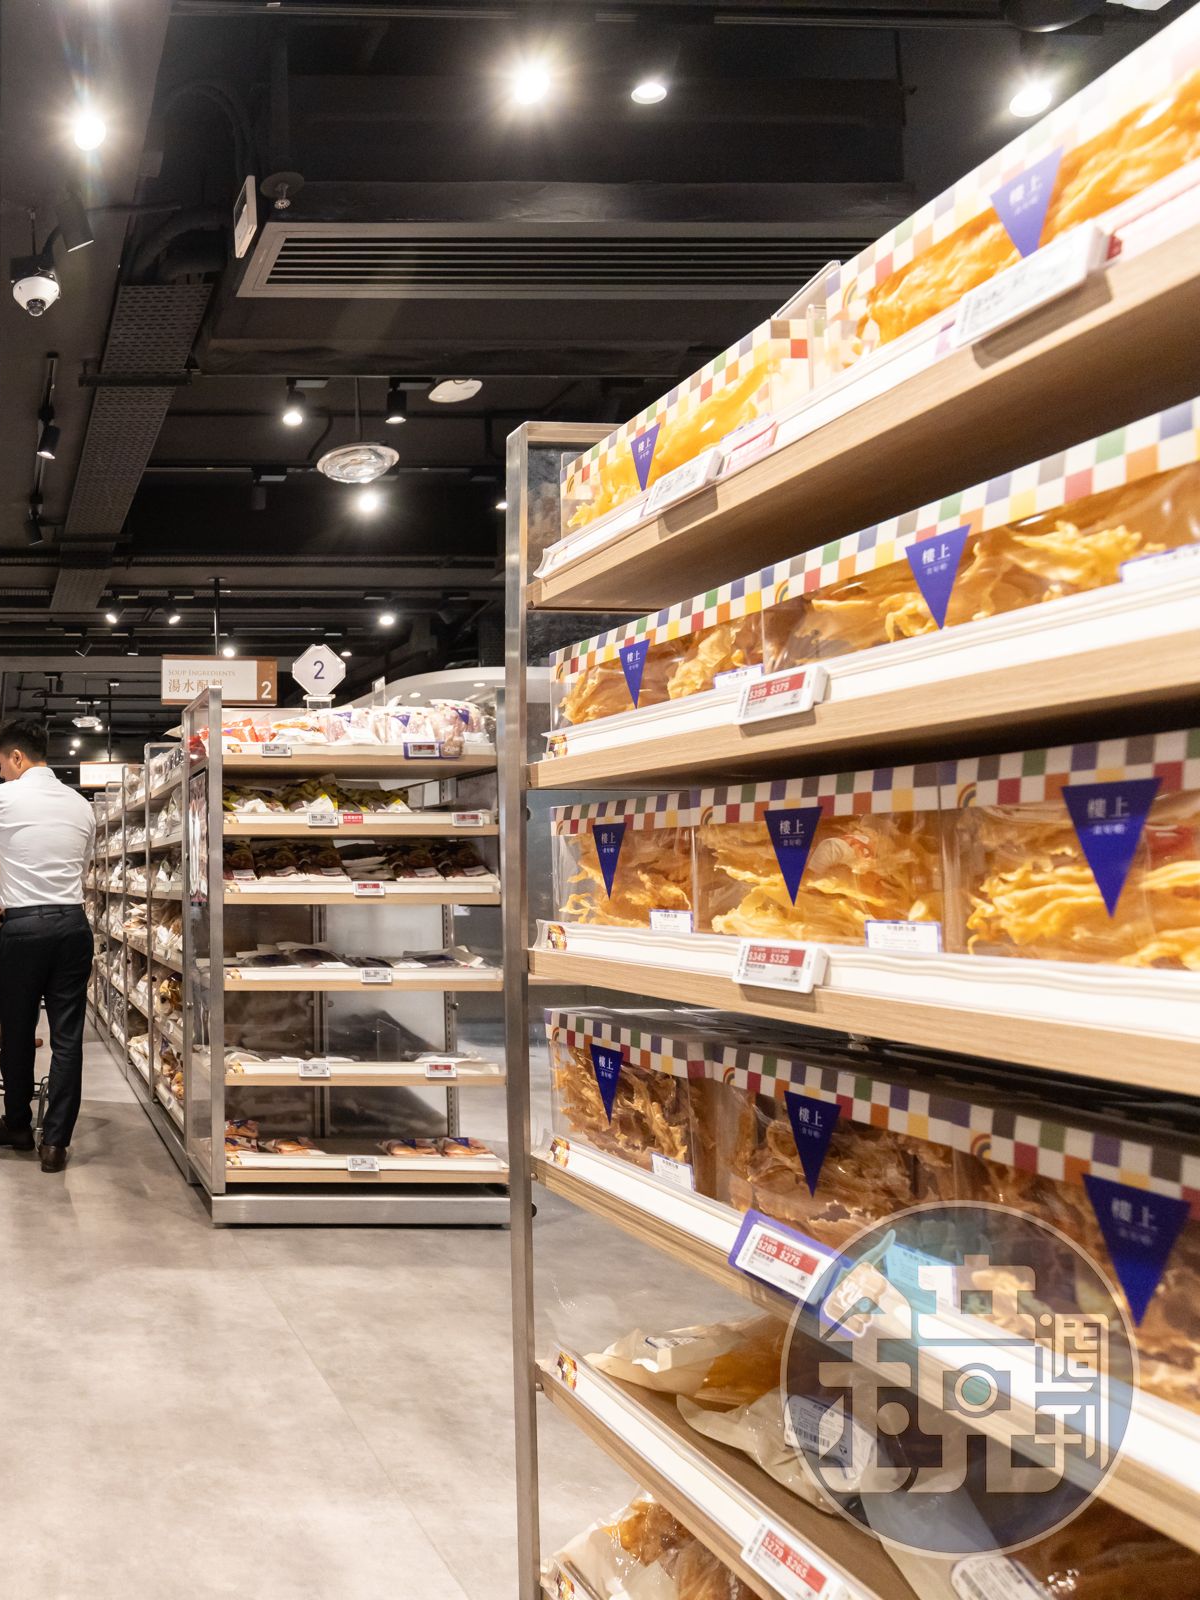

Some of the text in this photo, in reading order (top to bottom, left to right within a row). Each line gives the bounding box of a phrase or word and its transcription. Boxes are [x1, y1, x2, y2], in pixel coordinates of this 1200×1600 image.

[922, 543, 951, 565] 樓上
[313, 660, 325, 680] 2
[261, 680, 272, 699] 2
[770, 682, 790, 695] $379
[1087, 795, 1131, 819] 樓上
[780, 818, 805, 835] 樓上
[601, 831, 616, 845] 樓上
[748, 951, 790, 964] $349 $329
[598, 1055, 614, 1071] 樓上
[799, 1106, 823, 1128] 樓上
[1111, 1196, 1158, 1234] 樓上
[757, 1240, 778, 1256] $289
[779, 1250, 801, 1268] $275
